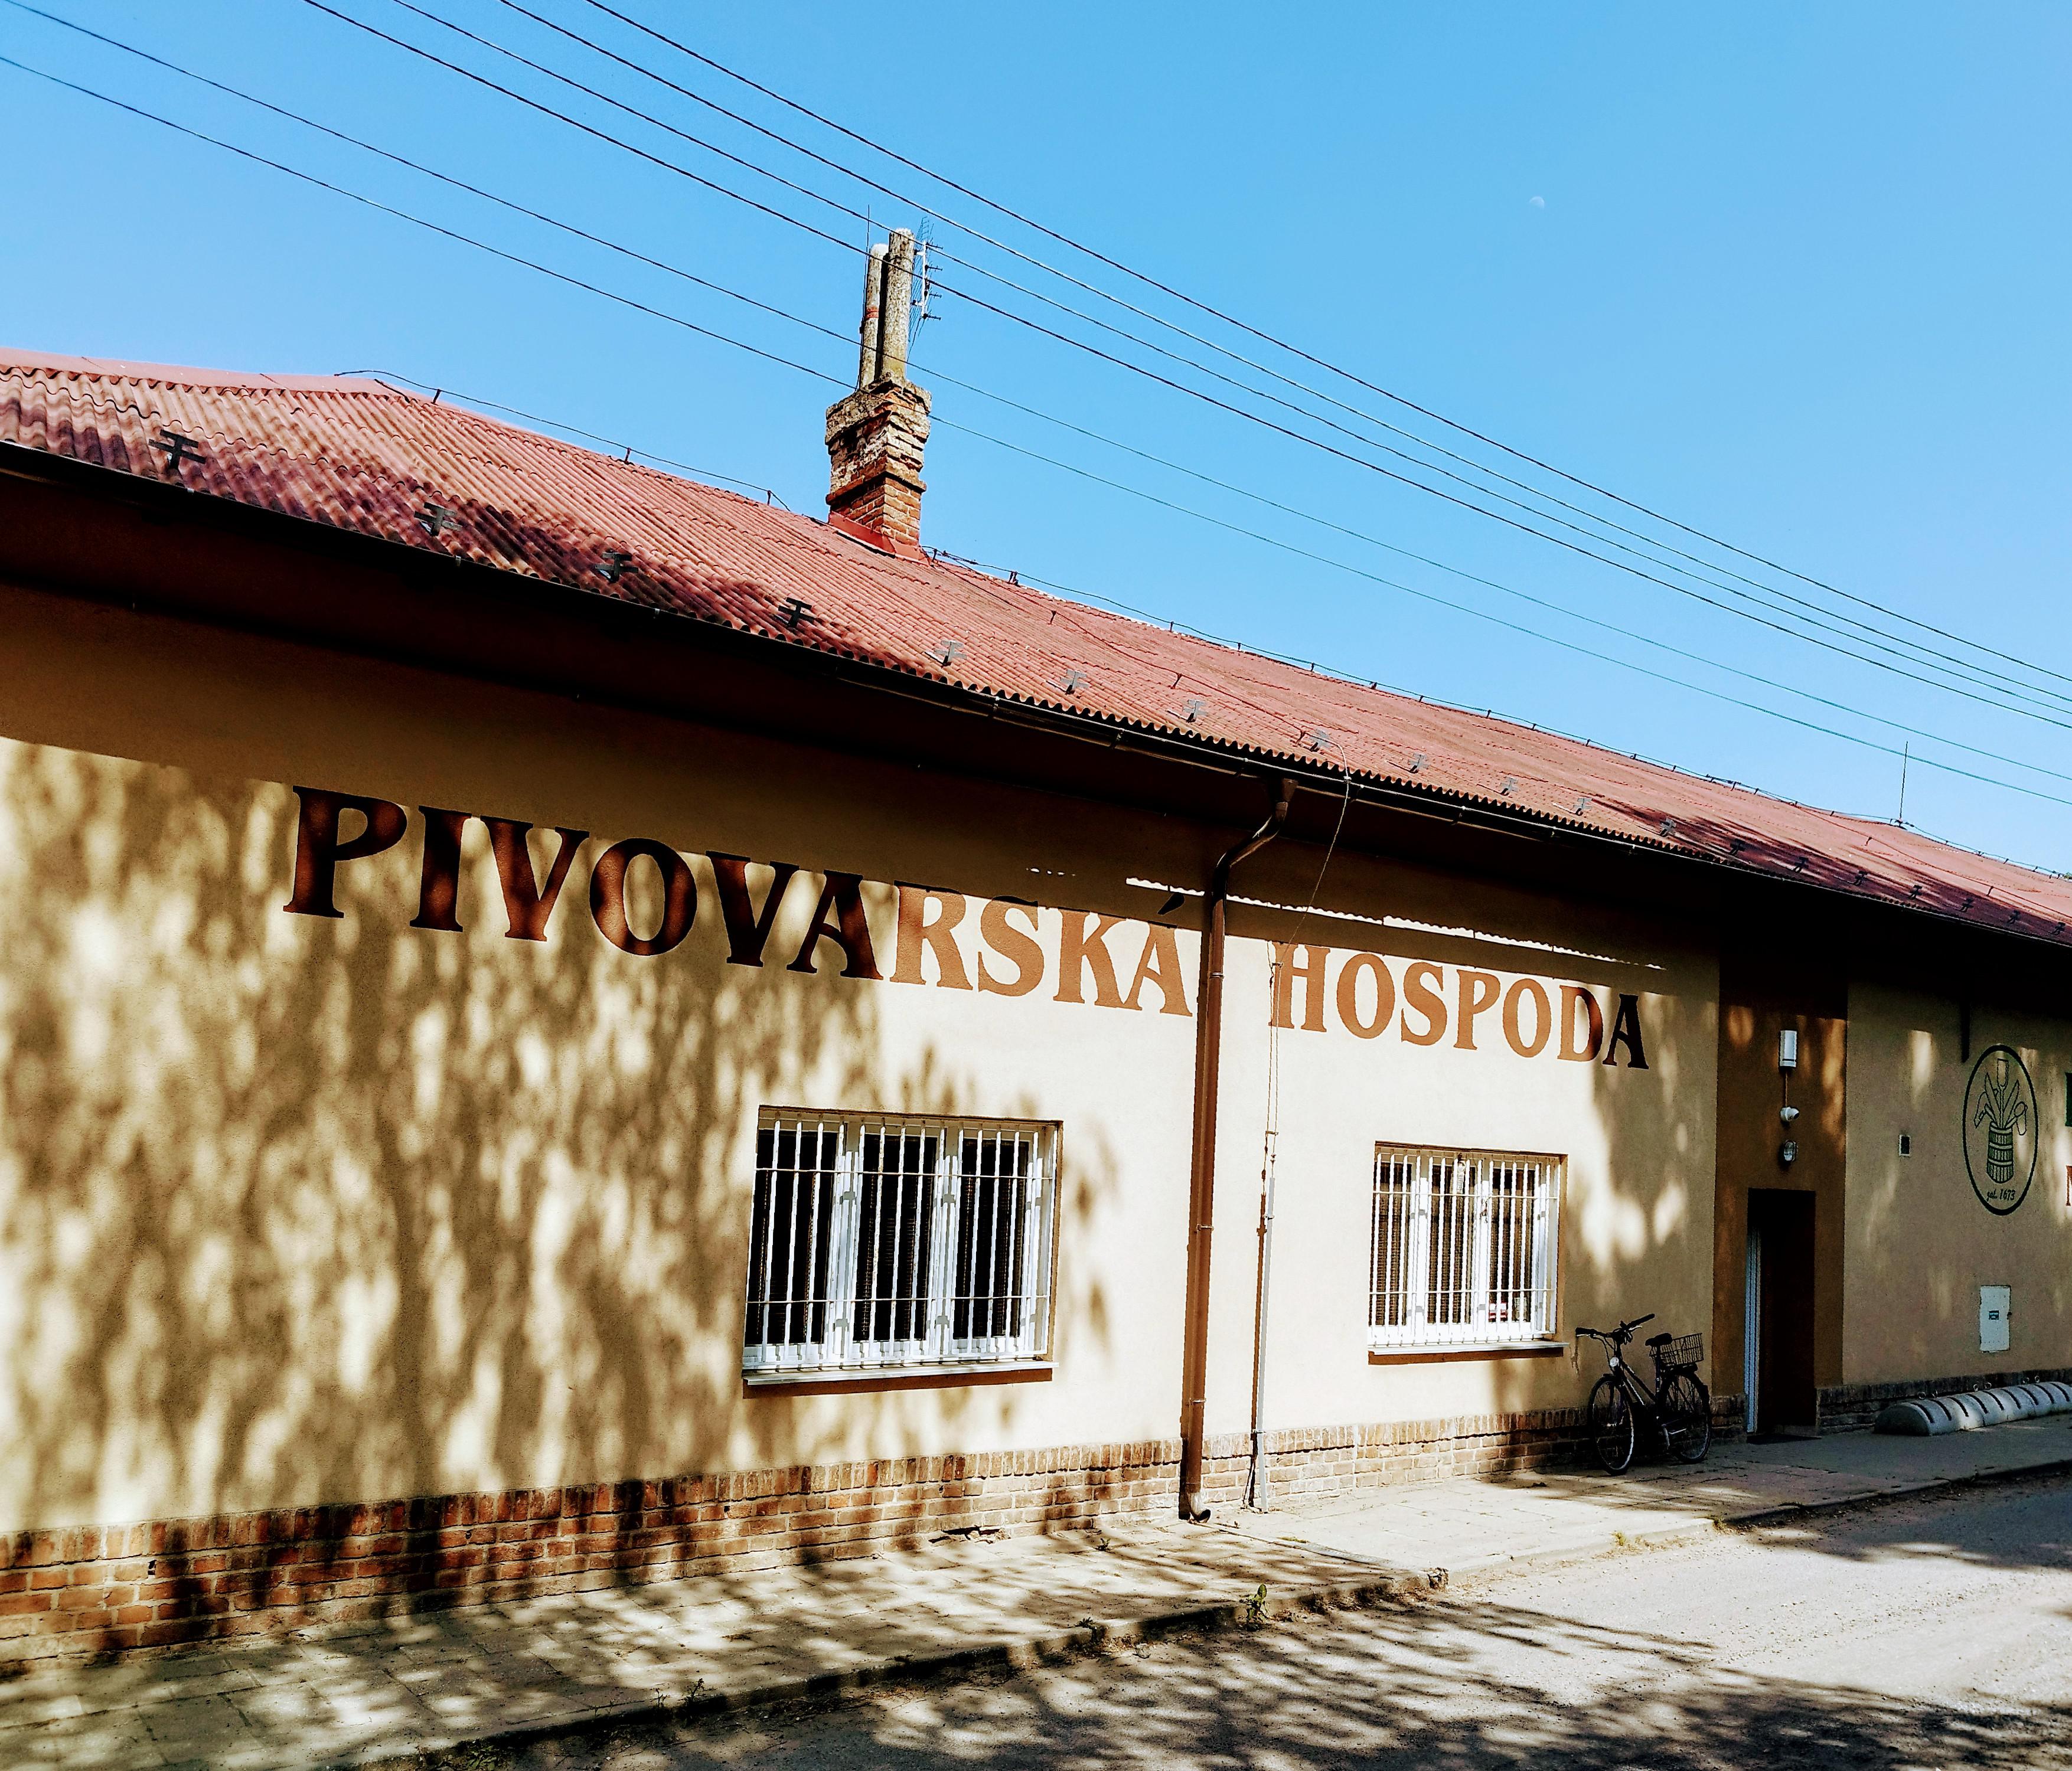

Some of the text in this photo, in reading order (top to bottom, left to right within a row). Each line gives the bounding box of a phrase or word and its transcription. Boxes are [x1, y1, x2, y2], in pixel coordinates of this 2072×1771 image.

[283, 786, 1649, 1069] PIVOVARSKÁ HOSPODA
[1999, 1188, 2016, 1201] 1673
